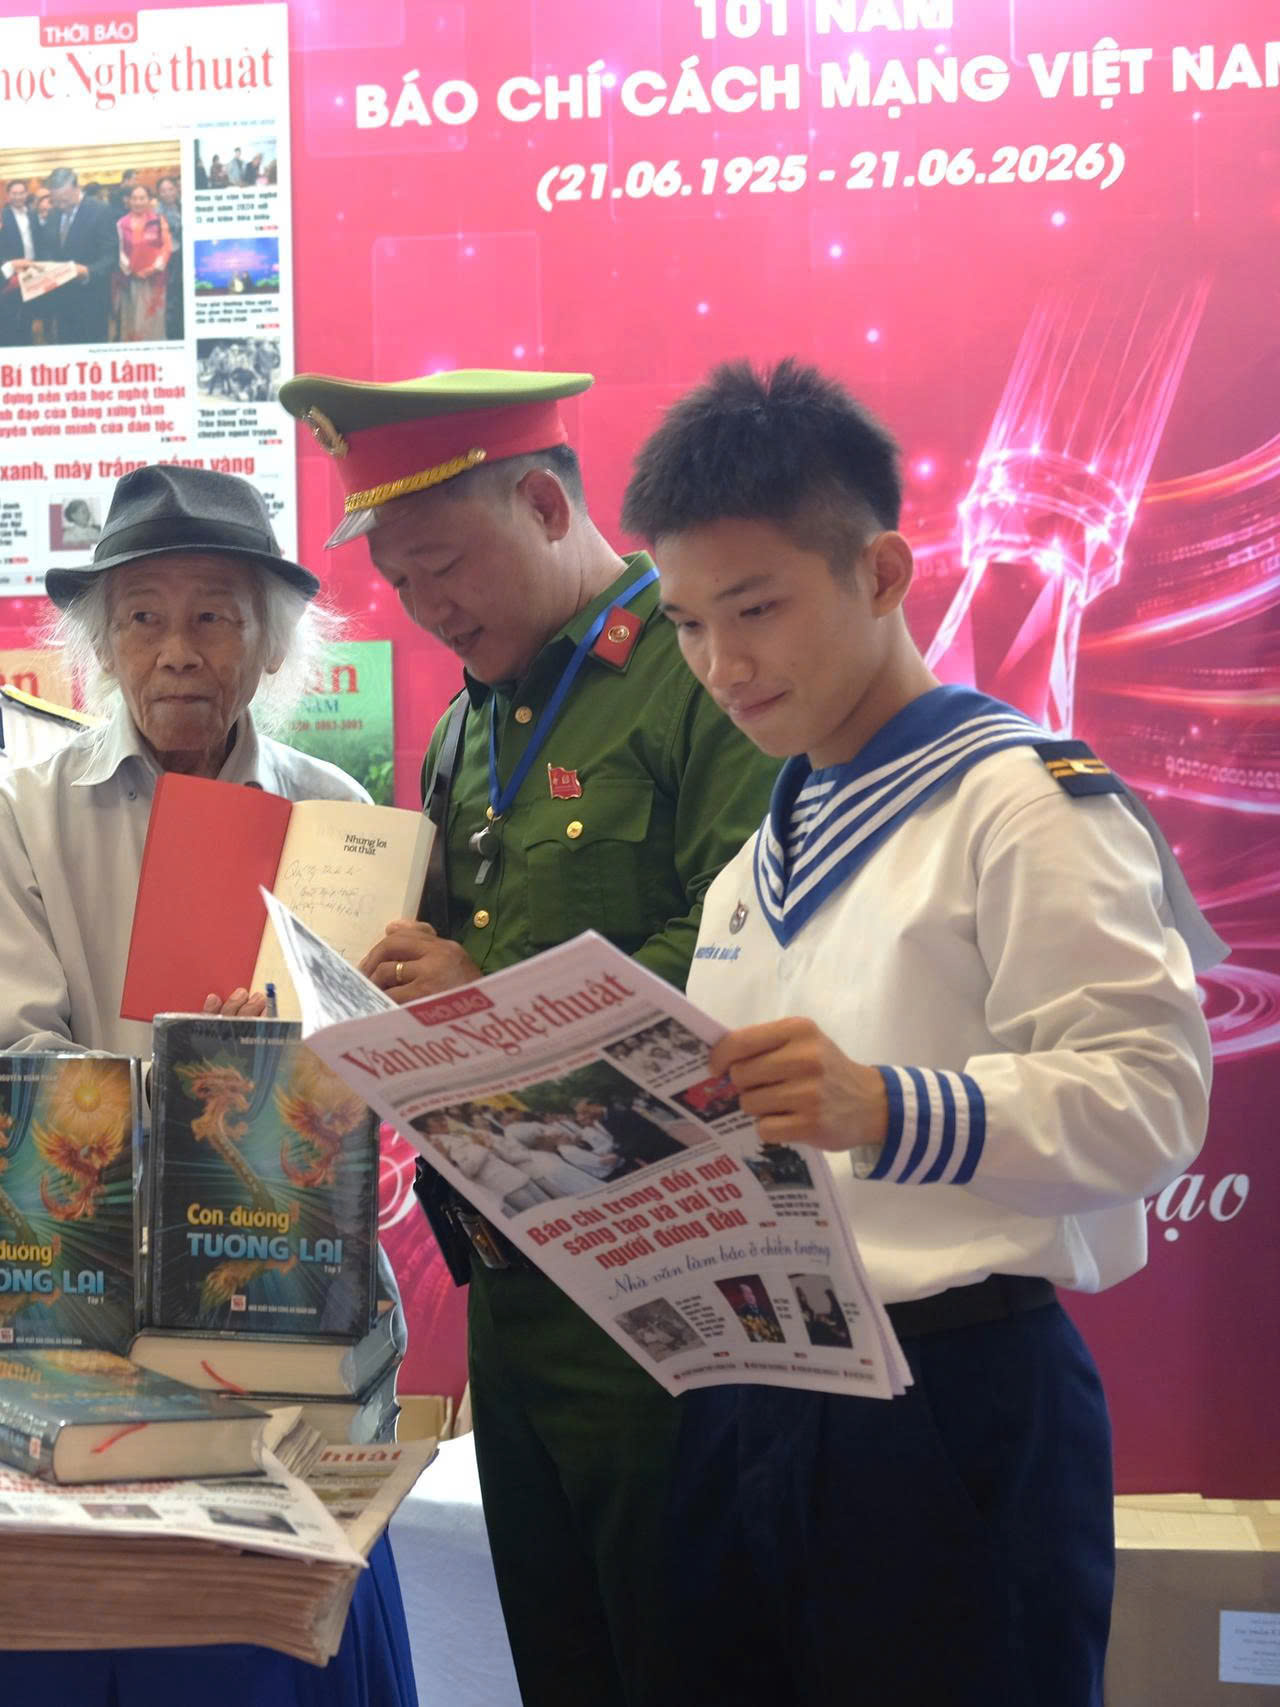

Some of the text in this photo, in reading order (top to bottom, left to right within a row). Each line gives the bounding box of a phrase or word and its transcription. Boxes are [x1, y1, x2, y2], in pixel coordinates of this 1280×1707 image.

[94, 21, 135, 41] BÁO
[694, 0, 953, 39] 101 NAM
[356, 37, 1280, 128] BÁO CHÍ CÁCH MẠNG VIỆT NA
[537, 154, 808, 212] (21.06.1925
[846, 142, 1126, 191] 21.06.2026)
[1, 363, 22, 388] Bí
[31, 362, 70, 387] thư
[76, 361, 103, 385] Tô
[111, 359, 163, 384] Lâm:
[187, 1203, 224, 1225] Con
[526, 1217, 573, 1247] Báo
[571, 1204, 607, 1228] chí
[602, 1185, 664, 1216] trong
[562, 1226, 618, 1257] sáng
[648, 1201, 679, 1223] và
[677, 1190, 712, 1215] vai
[1145, 1173, 1250, 1242] ạo
[186, 1232, 342, 1264] TƯƠNG LAI
[685, 1253, 718, 1273] làm
[63, 1269, 104, 1295] LAI
